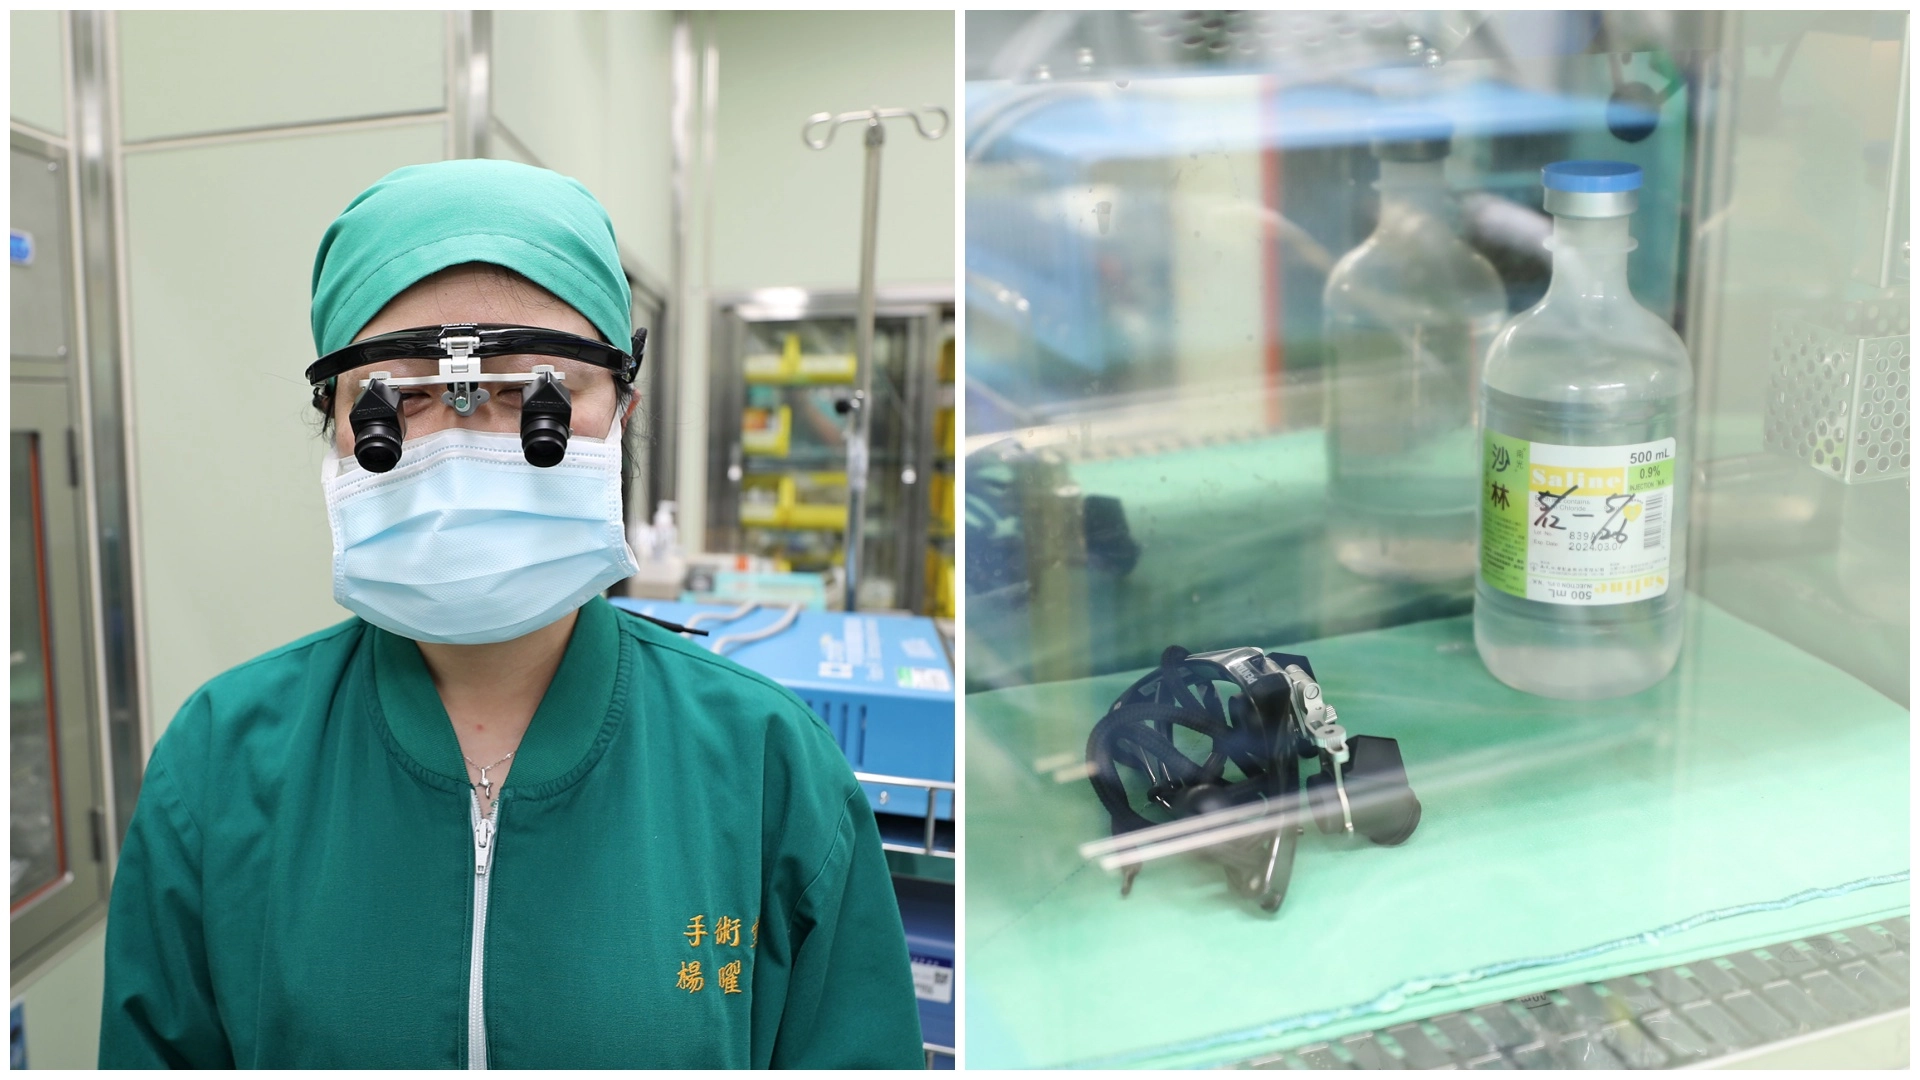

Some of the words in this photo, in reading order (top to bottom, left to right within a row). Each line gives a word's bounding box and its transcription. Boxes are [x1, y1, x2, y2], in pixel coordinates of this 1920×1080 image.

[1630, 450, 1653, 464] 500
[1655, 448, 1670, 460] mL
[1491, 443, 1511, 511] 沙林
[1531, 467, 1622, 490] Saline
[1639, 465, 1661, 480] 0.9%
[1548, 588, 1567, 598] mL
[1571, 590, 1592, 600] 500
[1594, 576, 1665, 596] Saline
[675, 959, 743, 995] 楊曜
